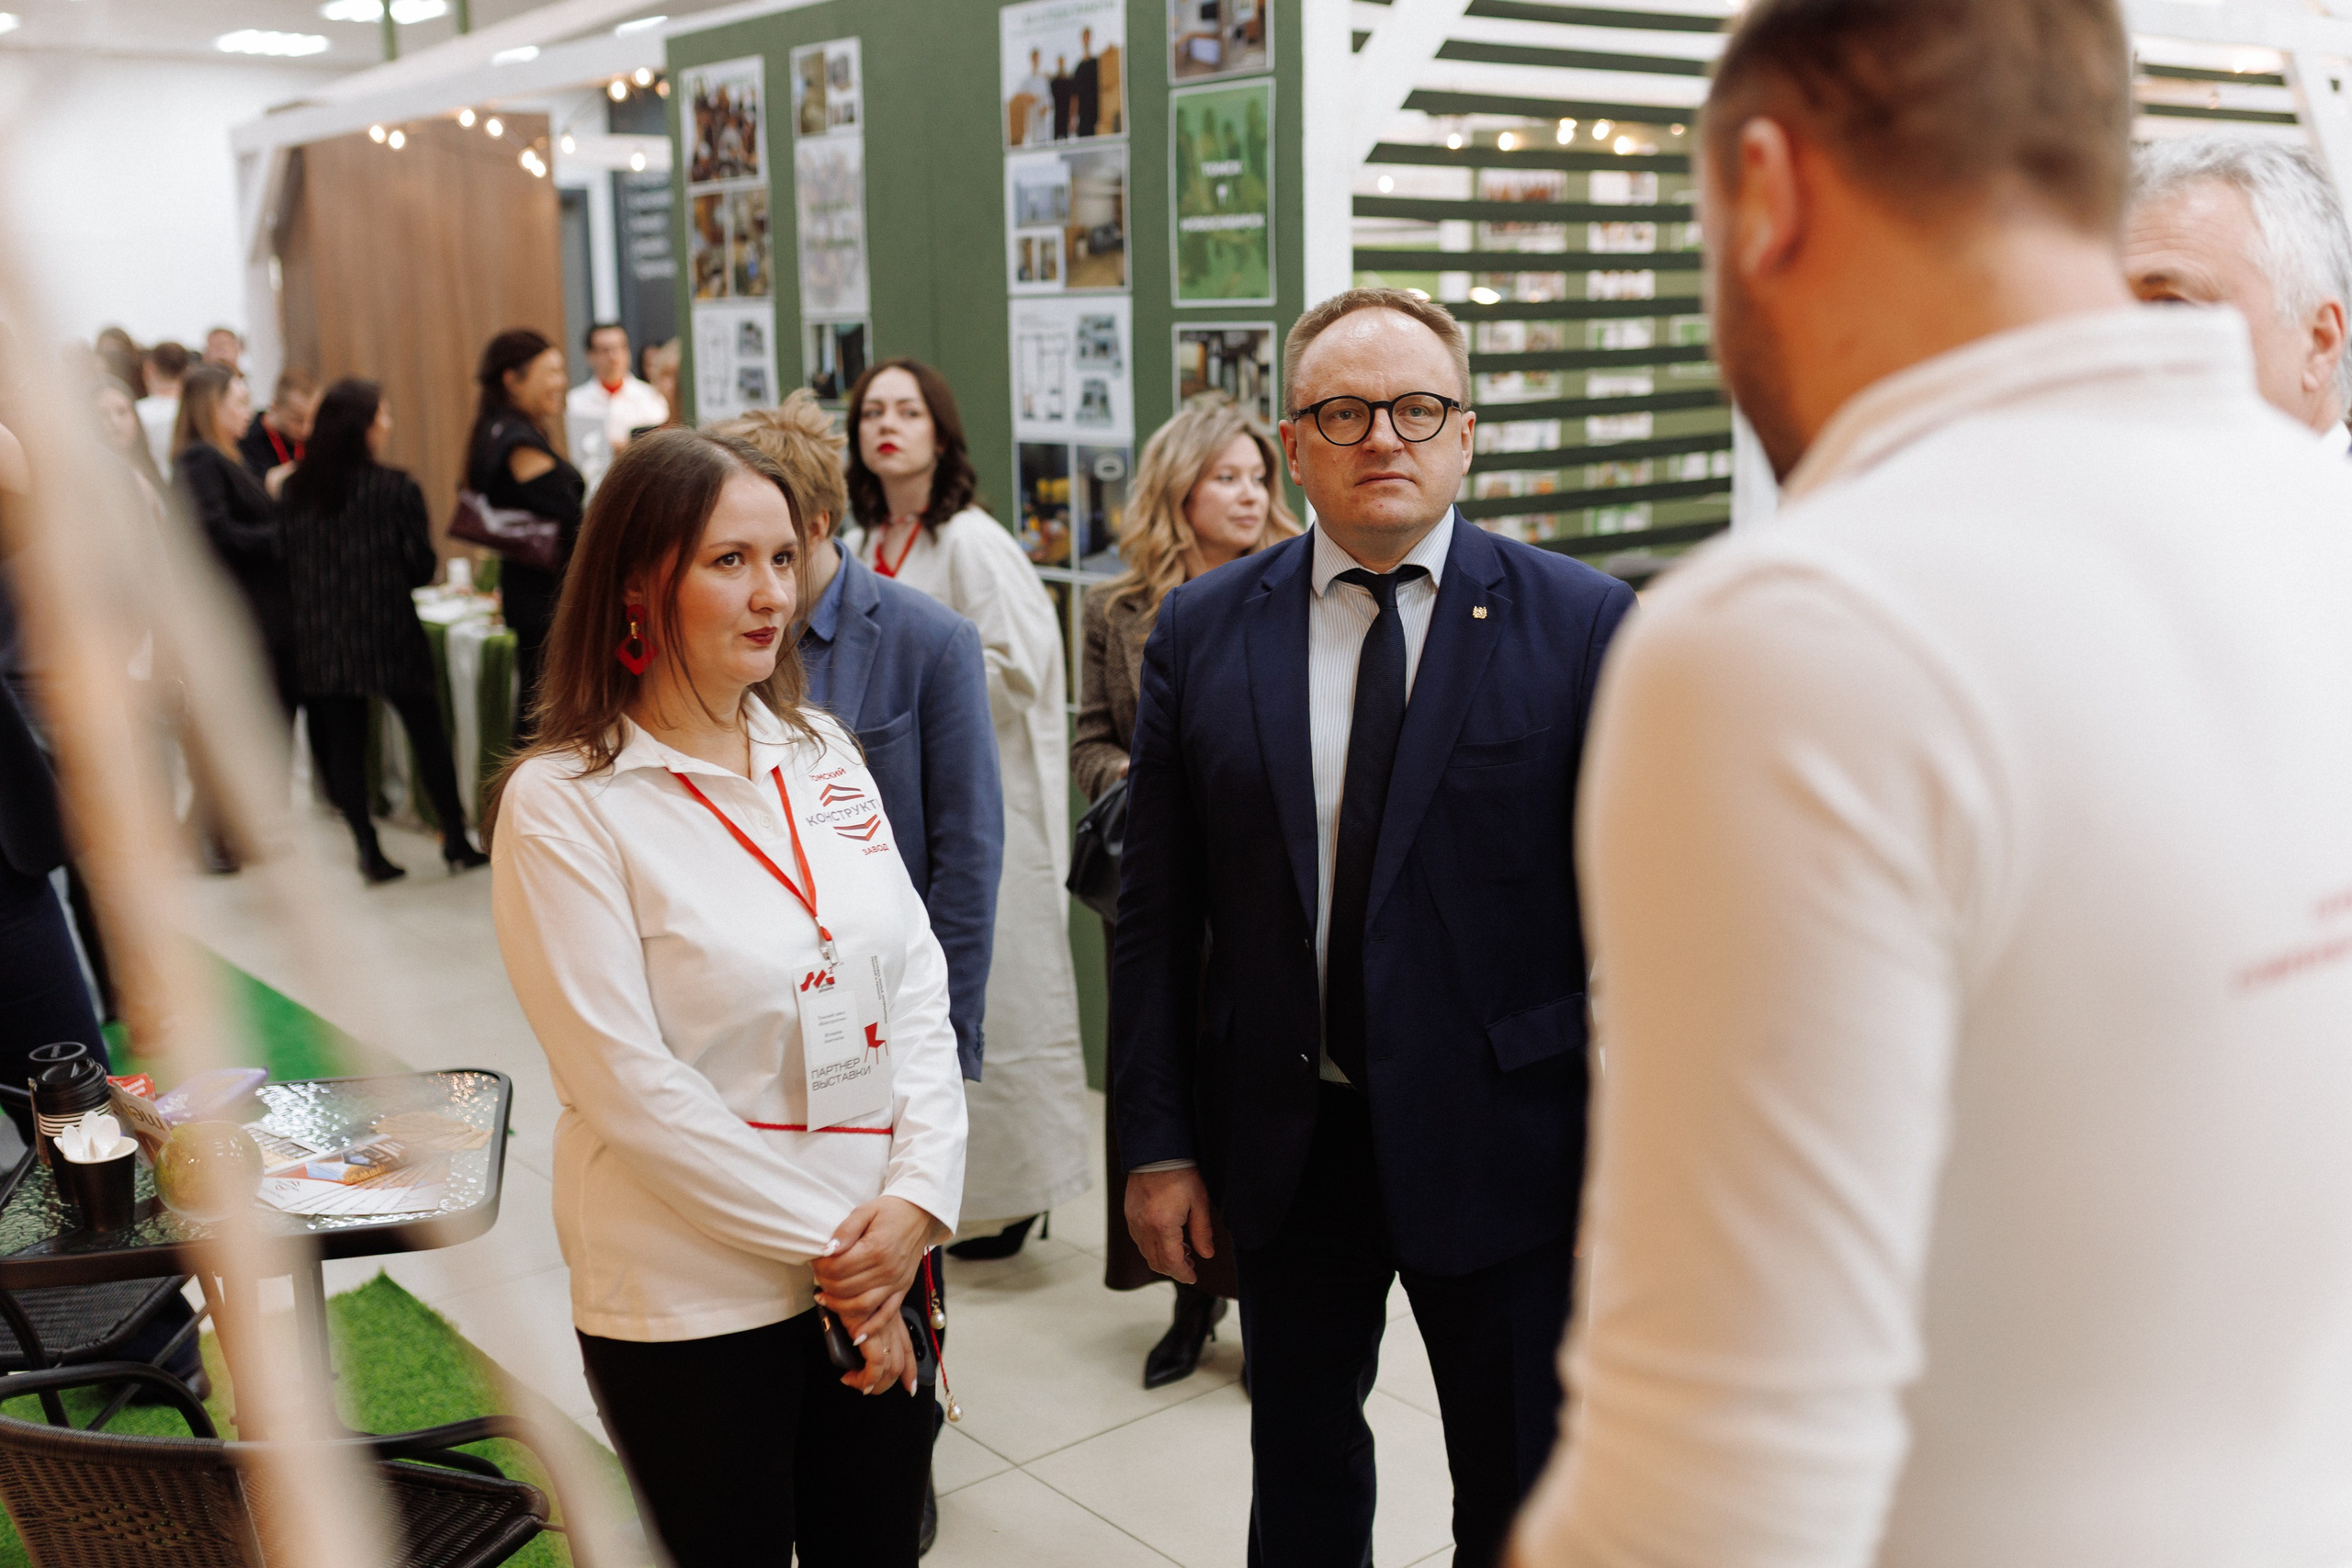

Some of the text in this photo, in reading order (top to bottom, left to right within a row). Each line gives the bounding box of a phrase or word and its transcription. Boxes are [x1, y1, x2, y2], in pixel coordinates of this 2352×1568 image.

[862, 843, 889, 856] ЗАВОД
[811, 1057, 860, 1079] ПАРТНЕР
[812, 1066, 872, 1091] ВЫСТАВКИ
